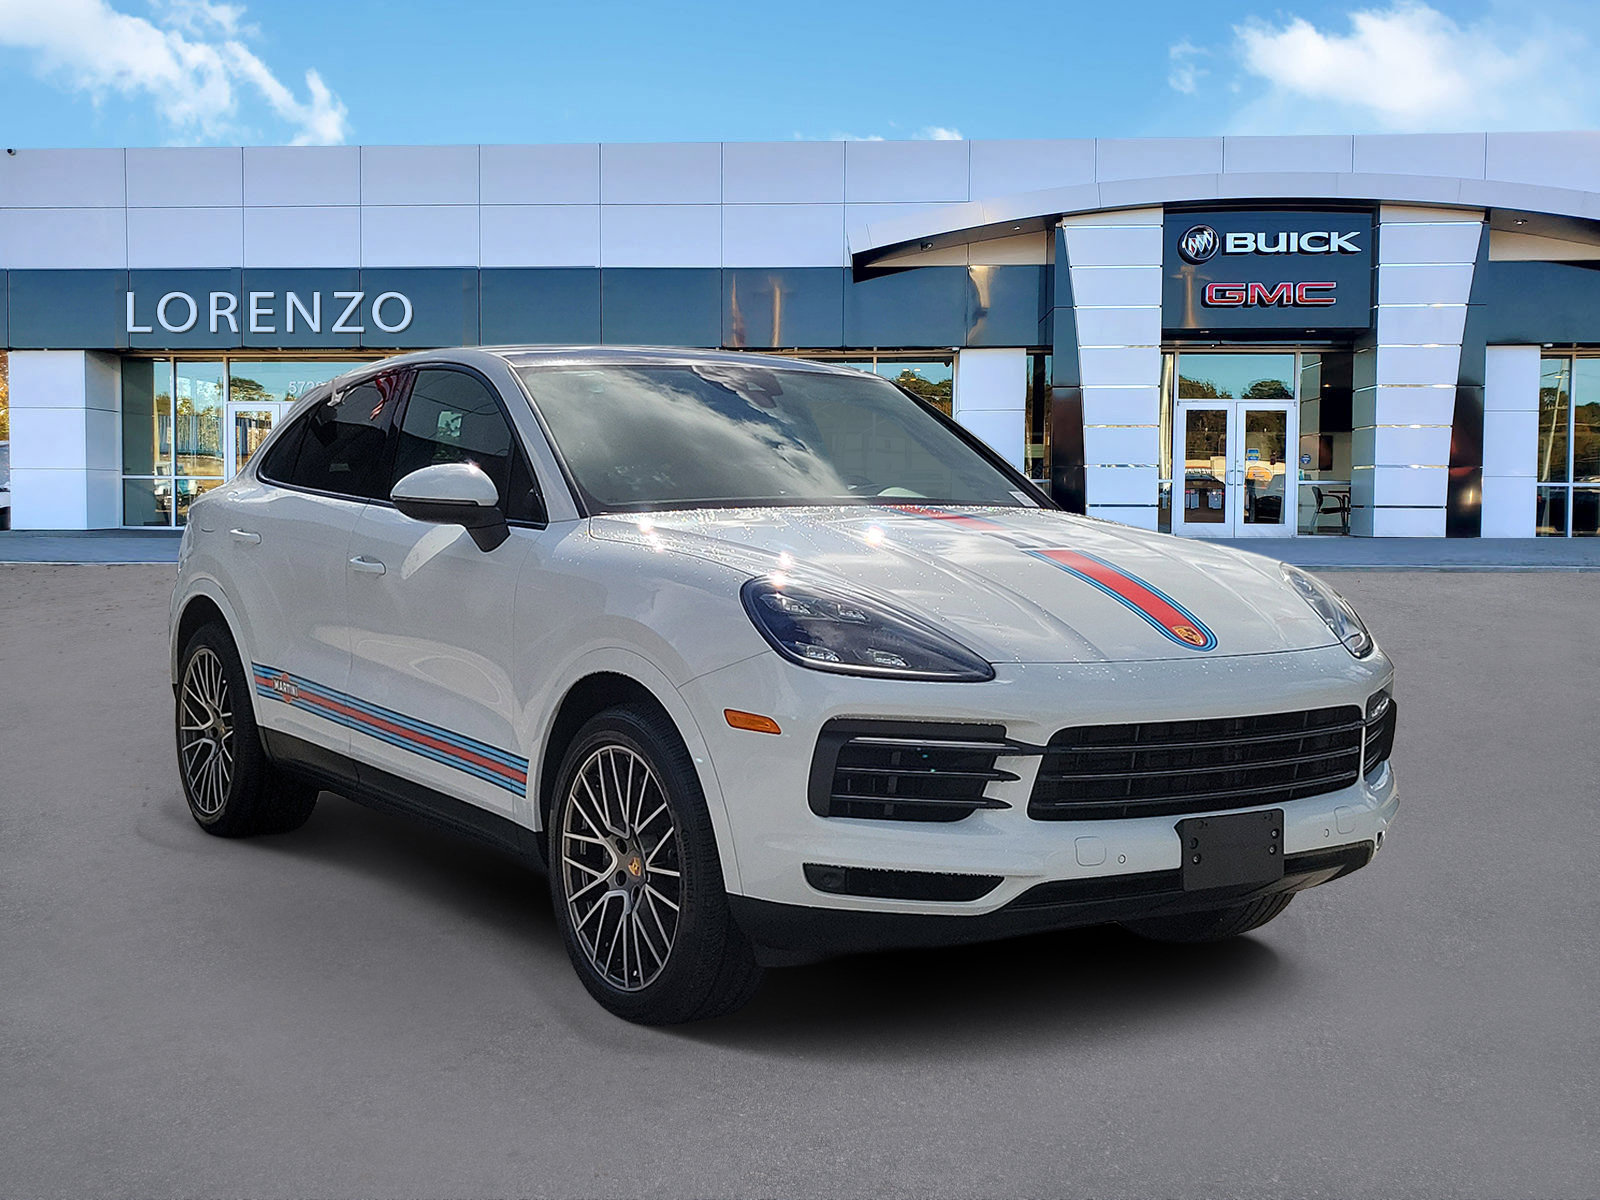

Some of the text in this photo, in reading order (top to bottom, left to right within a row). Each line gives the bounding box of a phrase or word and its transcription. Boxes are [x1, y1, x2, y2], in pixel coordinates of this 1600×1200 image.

[1225, 231, 1362, 253] BUICK
[1204, 282, 1337, 305] GMC
[126, 291, 414, 333] LORENZO
[288, 381, 322, 395] 572
